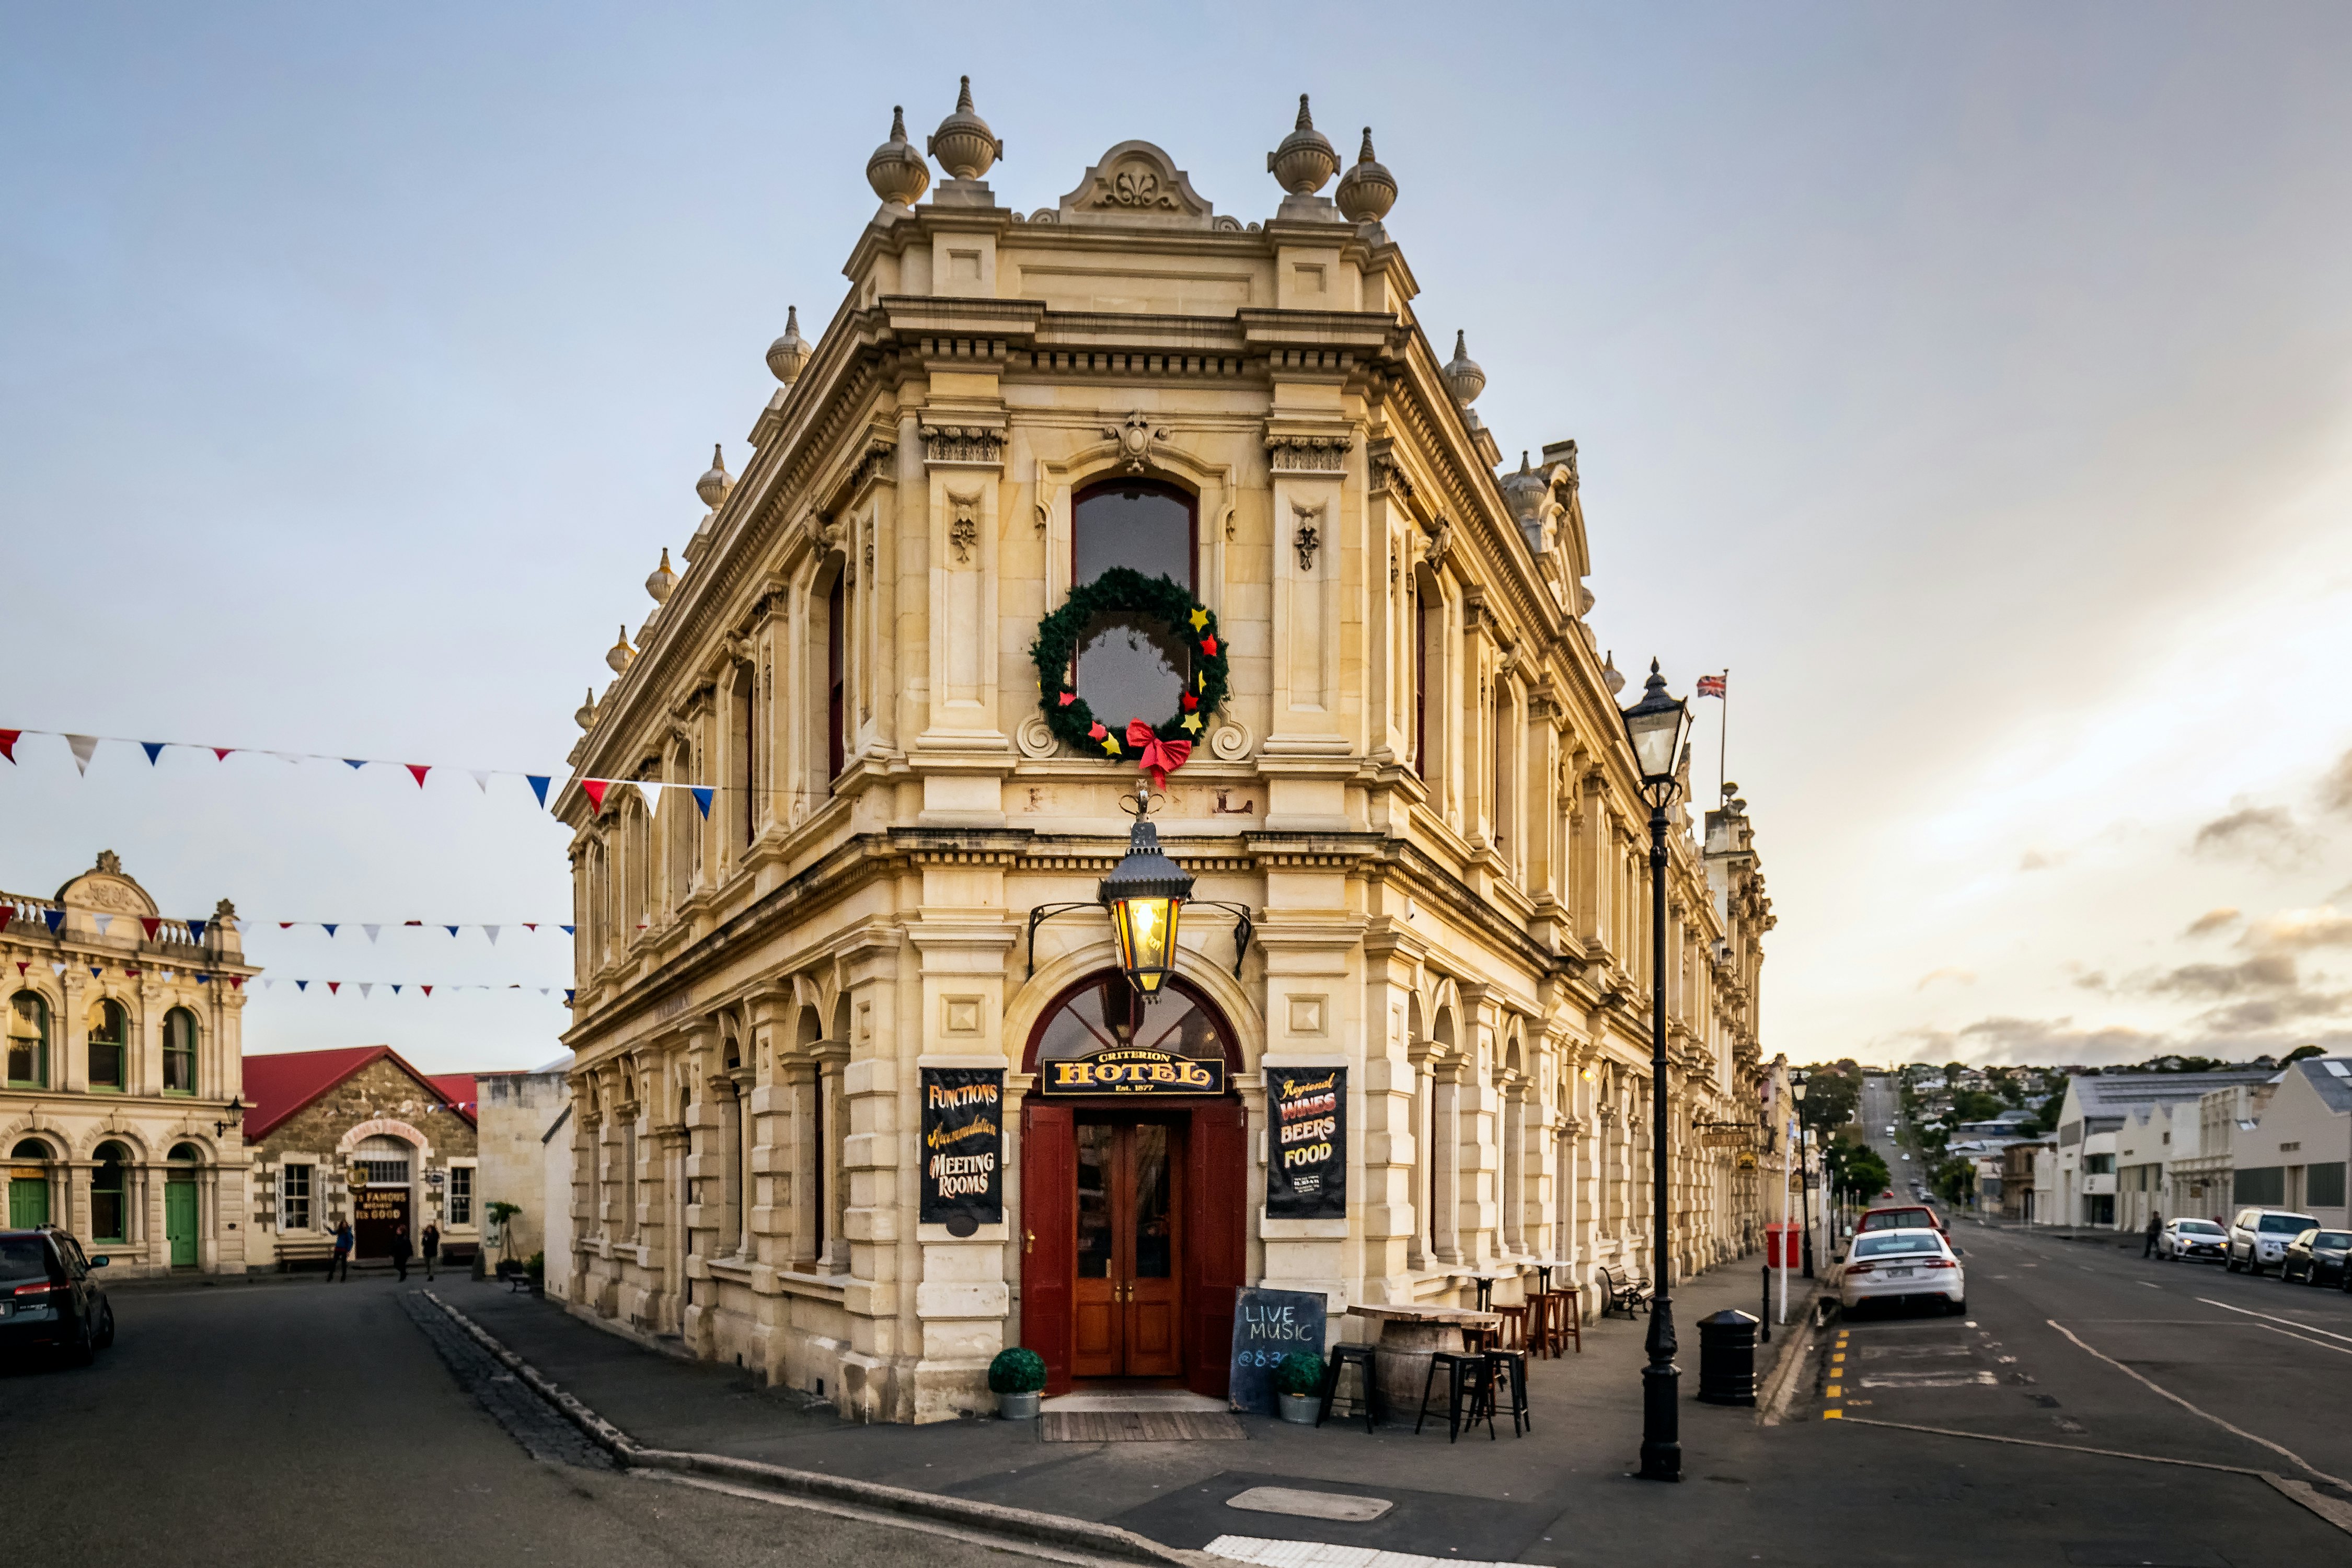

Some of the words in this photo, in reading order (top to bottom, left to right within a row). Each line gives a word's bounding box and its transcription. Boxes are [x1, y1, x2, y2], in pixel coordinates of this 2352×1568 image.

[1099, 1051, 1171, 1063] CRITERION
[1054, 1062, 1213, 1088] HOTEL
[1279, 1072, 1335, 1101] Regional
[929, 1084, 998, 1111] FUNCTIONS
[1279, 1092, 1336, 1121] WINES
[1281, 1116, 1336, 1144] BEERS
[929, 1151, 994, 1179] MEETING
[1284, 1142, 1332, 1169] FOOD
[938, 1172, 989, 1200] ROOMS
[1245, 1306, 1295, 1323] LIVE
[1250, 1322, 1313, 1341] MUSIC
